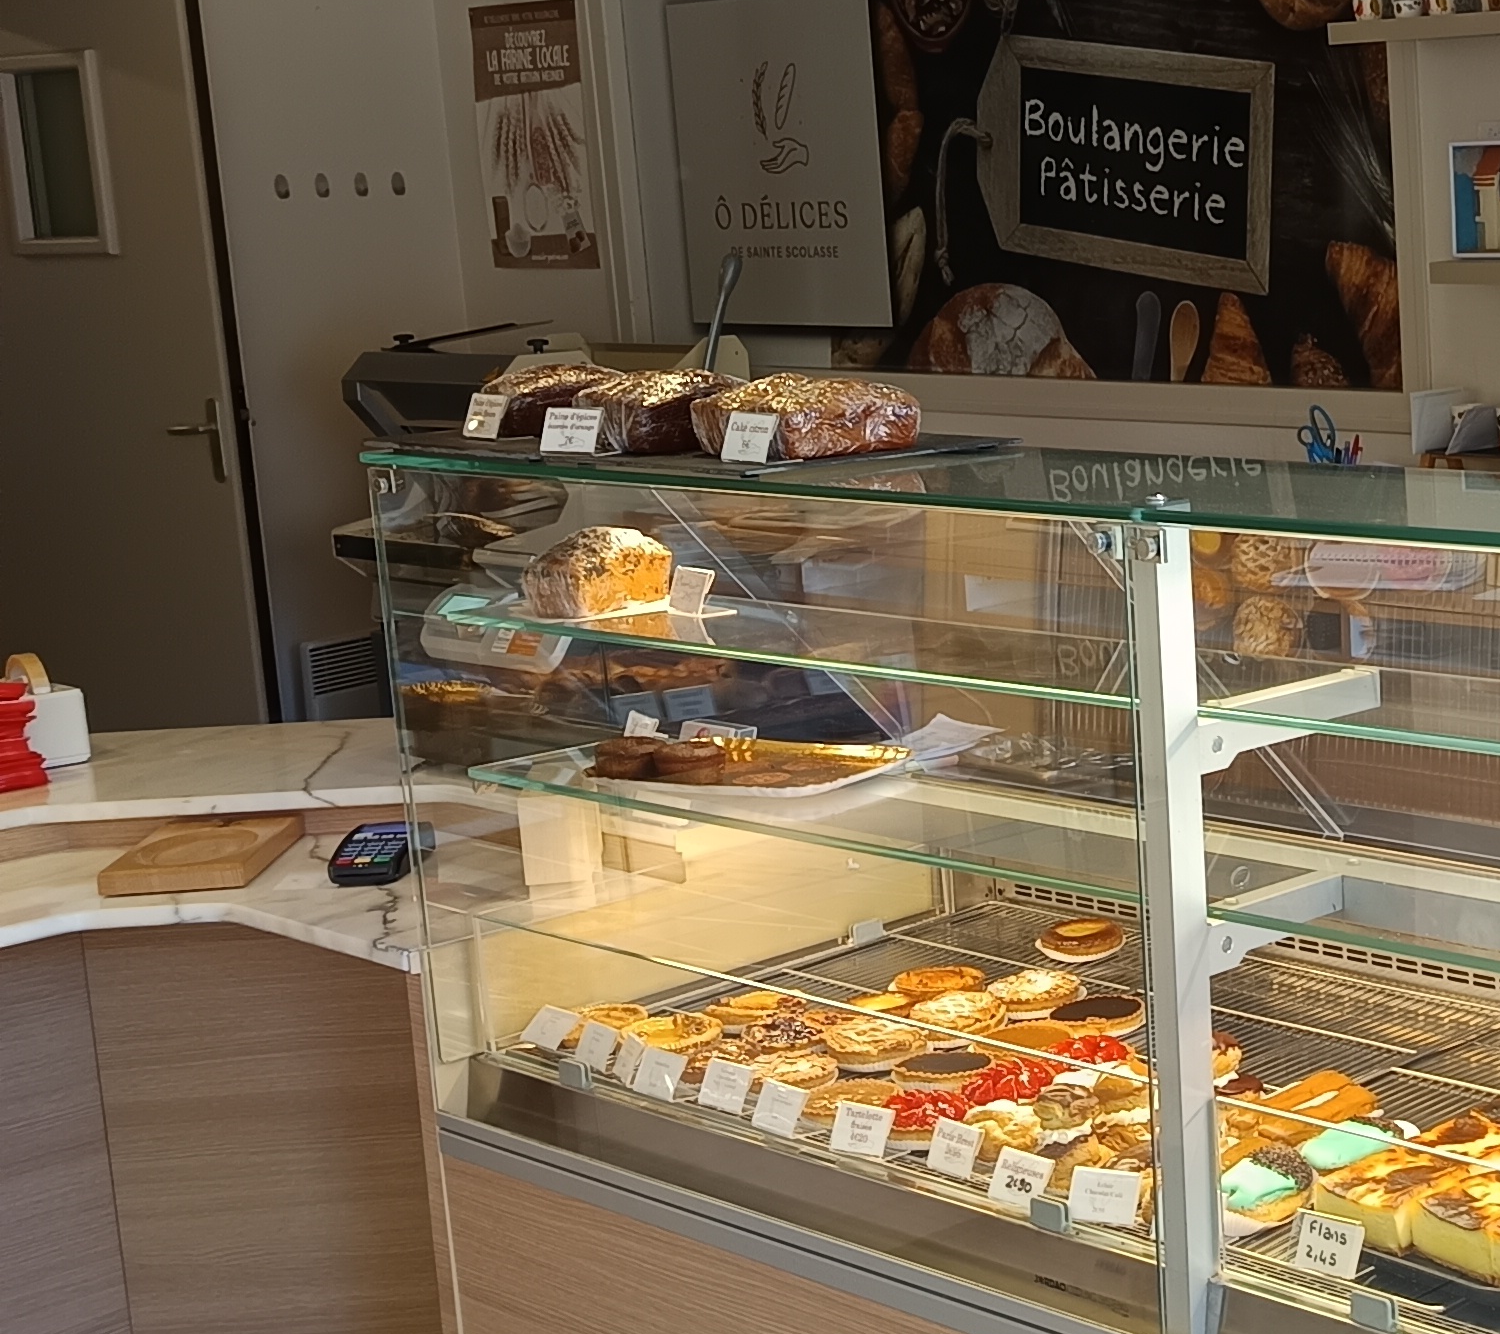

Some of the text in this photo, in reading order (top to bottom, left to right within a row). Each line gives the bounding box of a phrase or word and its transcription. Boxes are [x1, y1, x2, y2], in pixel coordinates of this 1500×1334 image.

[486, 50, 499, 72] LA
[536, 45, 571, 68] LOCALE
[1024, 98, 1245, 172] Boulangerie
[1040, 156, 1226, 224] Pâtisserie
[714, 194, 848, 230] Ô DÉLICES
[747, 246, 782, 259] SAINTE
[785, 245, 839, 259] SCOLASSE
[1310, 1220, 1347, 1245] Flans
[1306, 1244, 1336, 1266] 2,45
